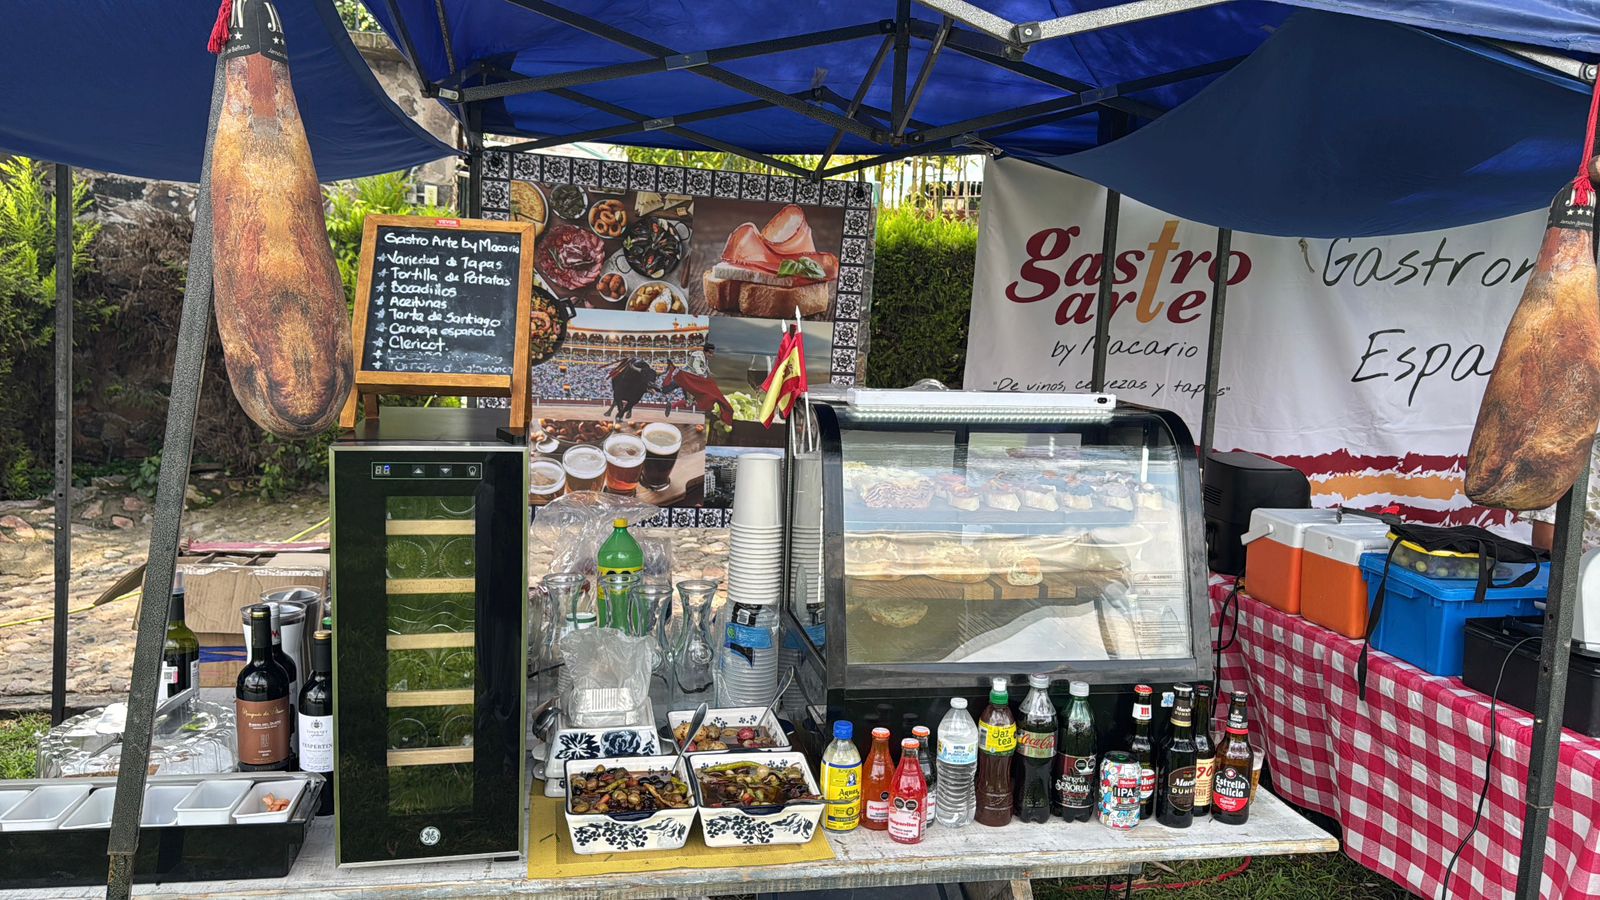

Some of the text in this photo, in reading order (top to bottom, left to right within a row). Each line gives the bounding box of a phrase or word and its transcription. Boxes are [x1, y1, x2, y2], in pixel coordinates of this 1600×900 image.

[384, 232, 429, 247] Gastro
[431, 235, 459, 249] Arte
[461, 237, 478, 254] by
[387, 250, 503, 272] Variedad de Tapas
[1005, 220, 1252, 304] gastro
[390, 267, 438, 282] Tortilla
[444, 272, 459, 283] de
[391, 281, 457, 297] Bocadillos
[389, 296, 447, 310] Aceitunas
[388, 308, 501, 328] Tarta de Santiago
[1050, 340, 1077, 367] by
[1026, 380, 1067, 392] vinos,
[1151, 382, 1163, 397] y
[1174, 381, 1232, 400] taps"
[1216, 775, 1245, 789] Estrella
[1216, 785, 1243, 797] Galicia
[1117, 787, 1134, 797] IPA
